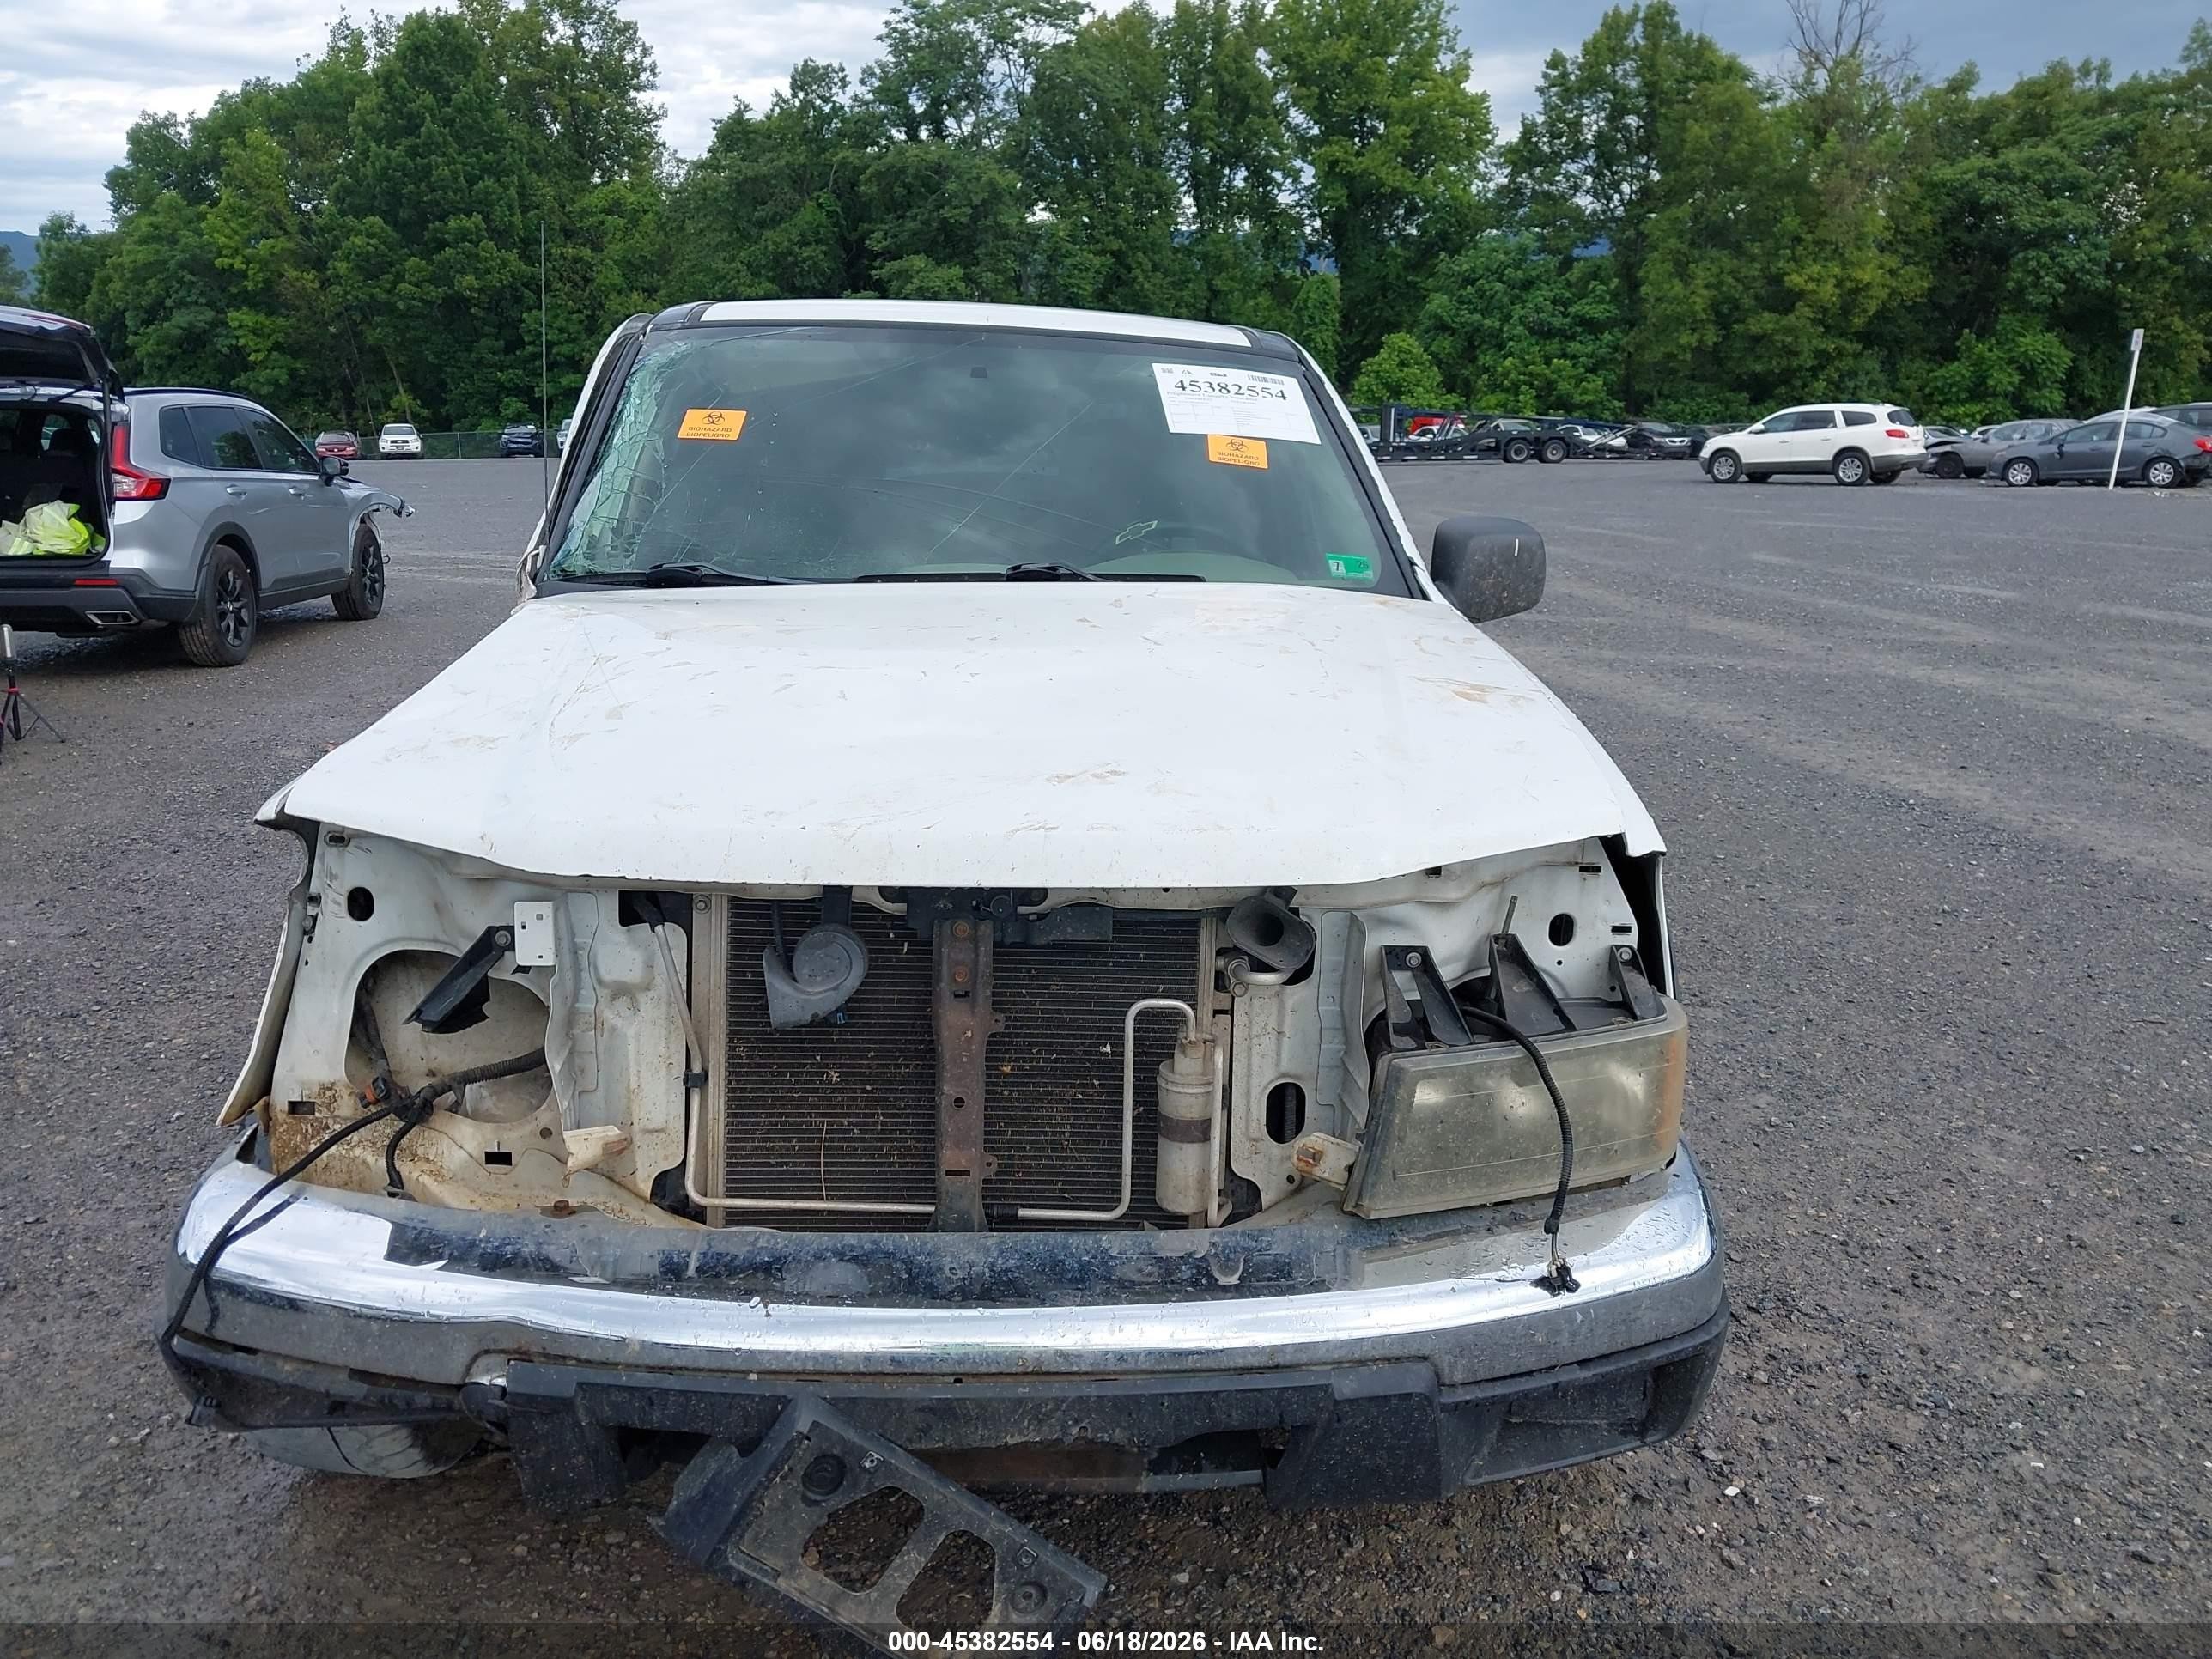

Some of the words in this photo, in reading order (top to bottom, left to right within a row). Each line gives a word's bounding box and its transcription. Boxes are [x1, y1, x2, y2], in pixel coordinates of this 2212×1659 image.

[1174, 379, 1288, 401] 45382554
[1217, 451, 1259, 461] BIOHAZARD
[1217, 456, 1260, 466] BIOPELIGRO
[1333, 561, 1340, 571] 7
